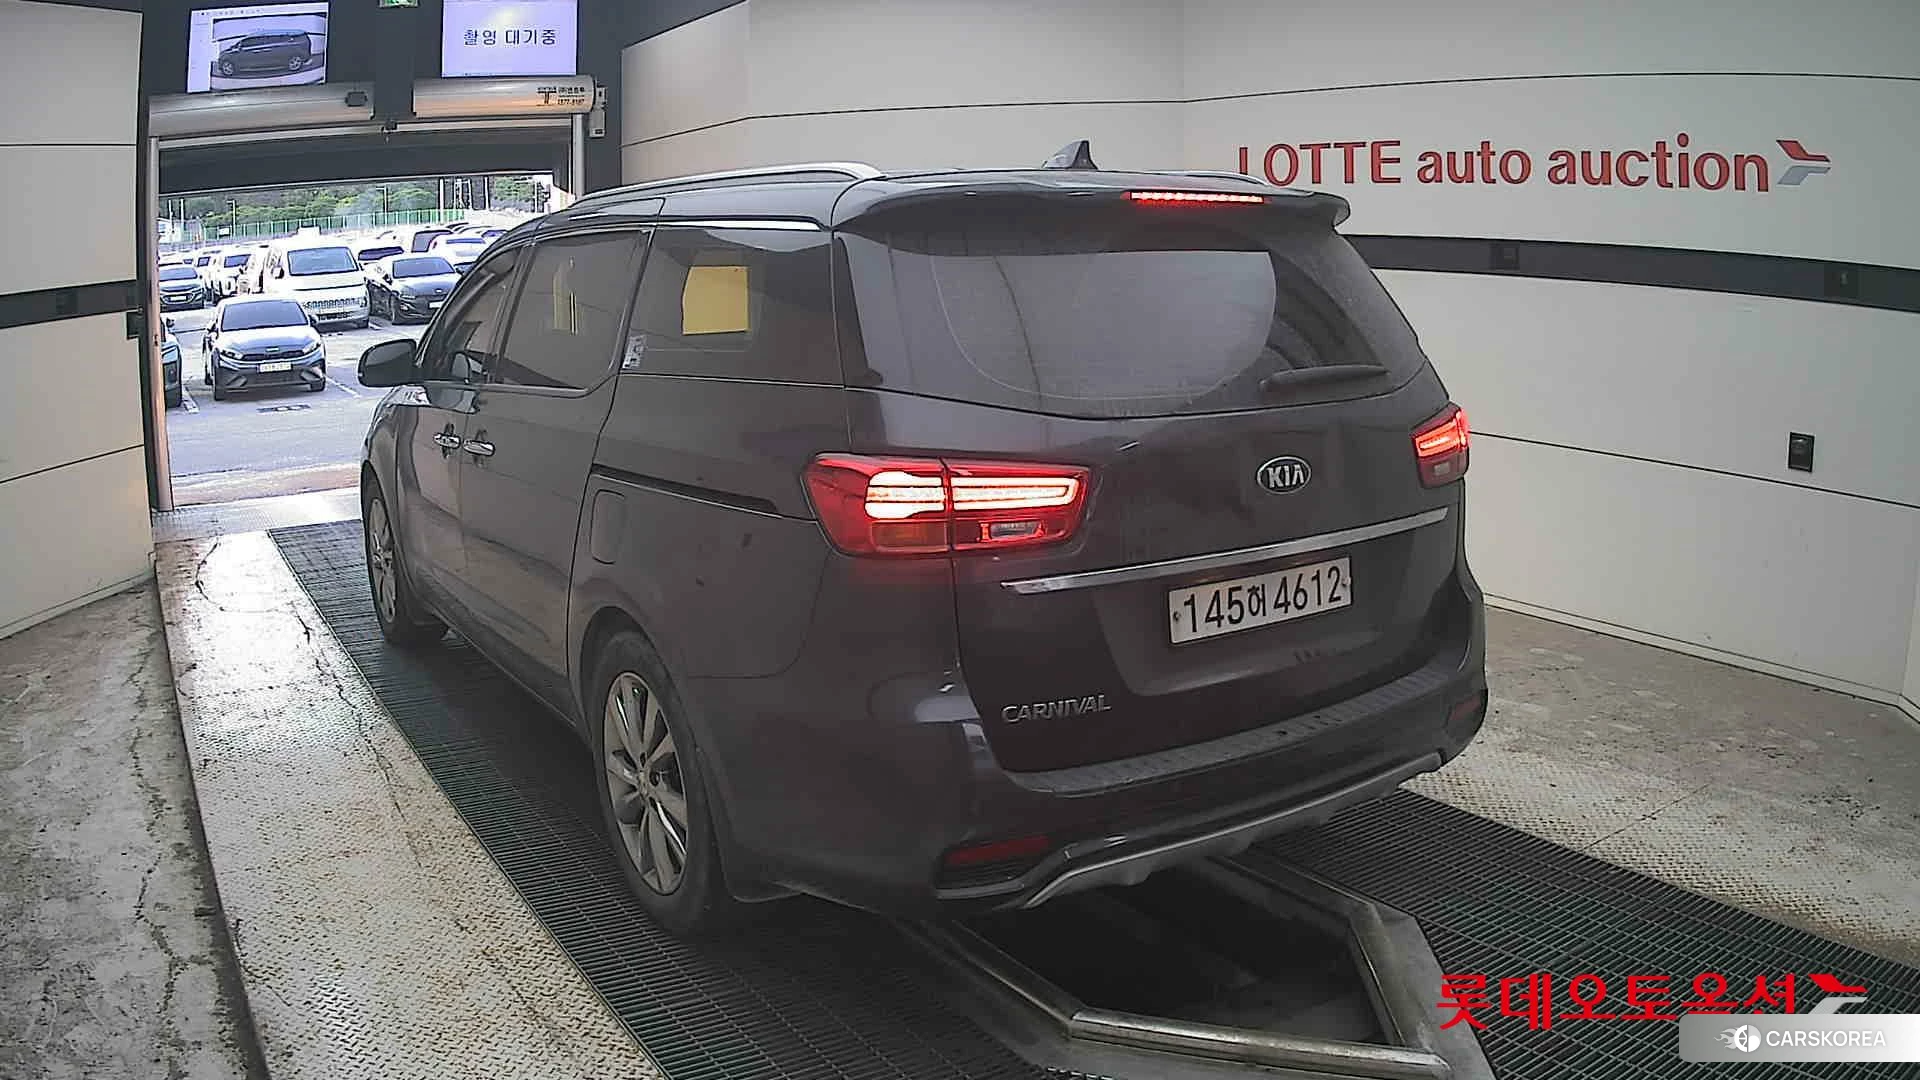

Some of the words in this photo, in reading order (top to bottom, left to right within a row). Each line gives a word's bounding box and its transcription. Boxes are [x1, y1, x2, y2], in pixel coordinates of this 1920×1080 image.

[463, 29, 497, 46] 촬영
[505, 29, 556, 46] 대기중
[1416, 140, 1531, 184] auto
[1548, 133, 1769, 193] auction
[1265, 463, 1305, 489] KIA
[1001, 694, 1112, 722] CARNIVAL
